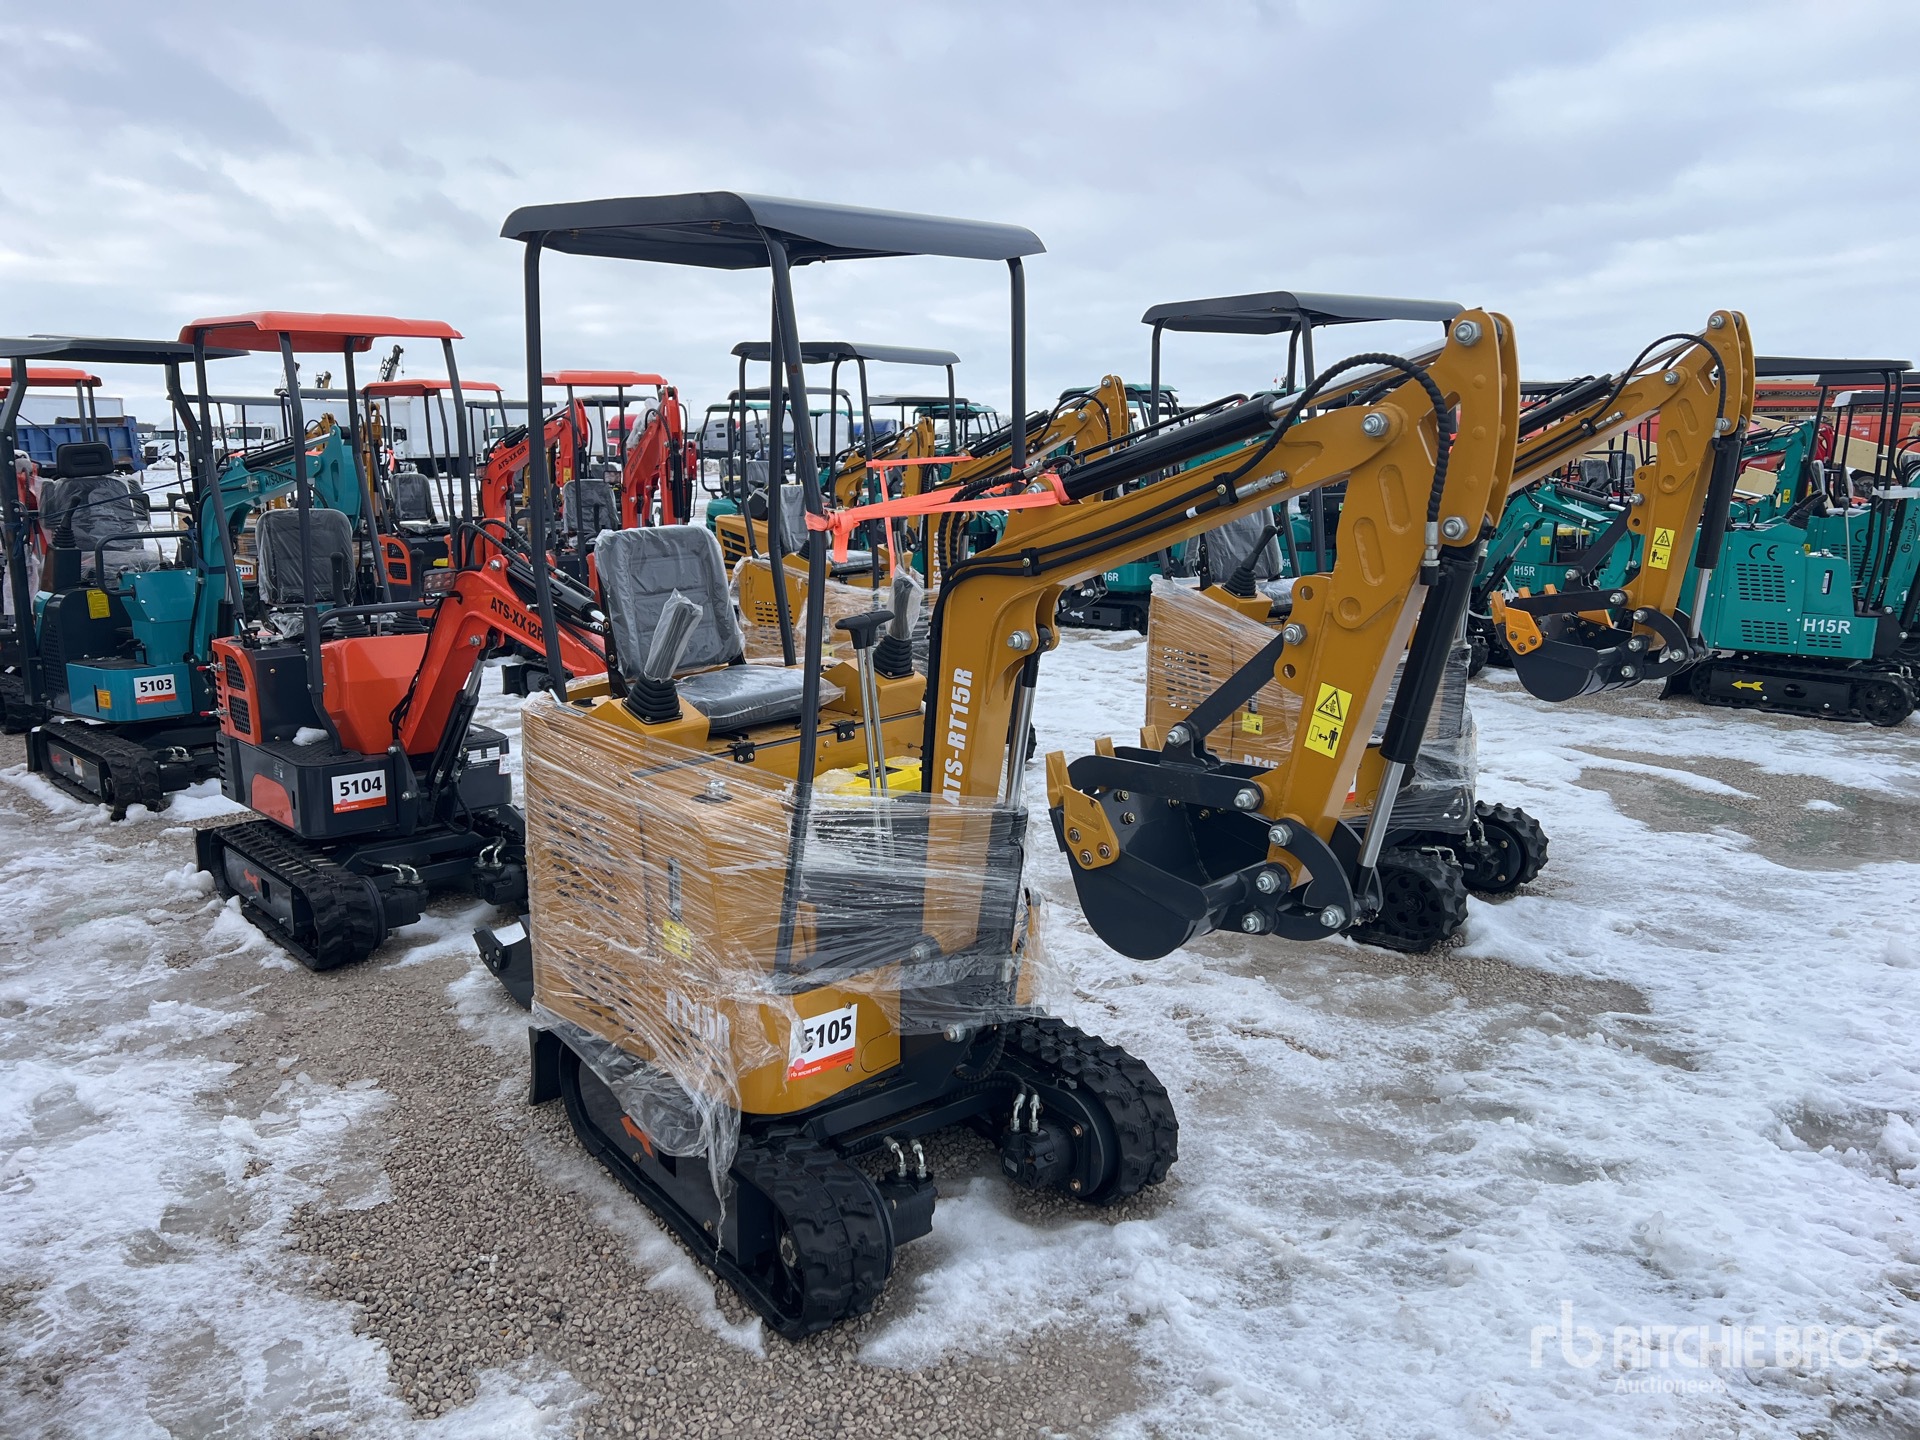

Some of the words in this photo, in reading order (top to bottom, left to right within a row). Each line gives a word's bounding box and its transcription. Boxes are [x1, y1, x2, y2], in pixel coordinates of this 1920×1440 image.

[1513, 565, 1535, 576] H15R
[1803, 618, 1851, 635] H15R
[140, 678, 172, 692] 5103
[942, 667, 973, 807] ATS-RT15R
[340, 776, 382, 797] 5104
[801, 1015, 852, 1054] 5105
